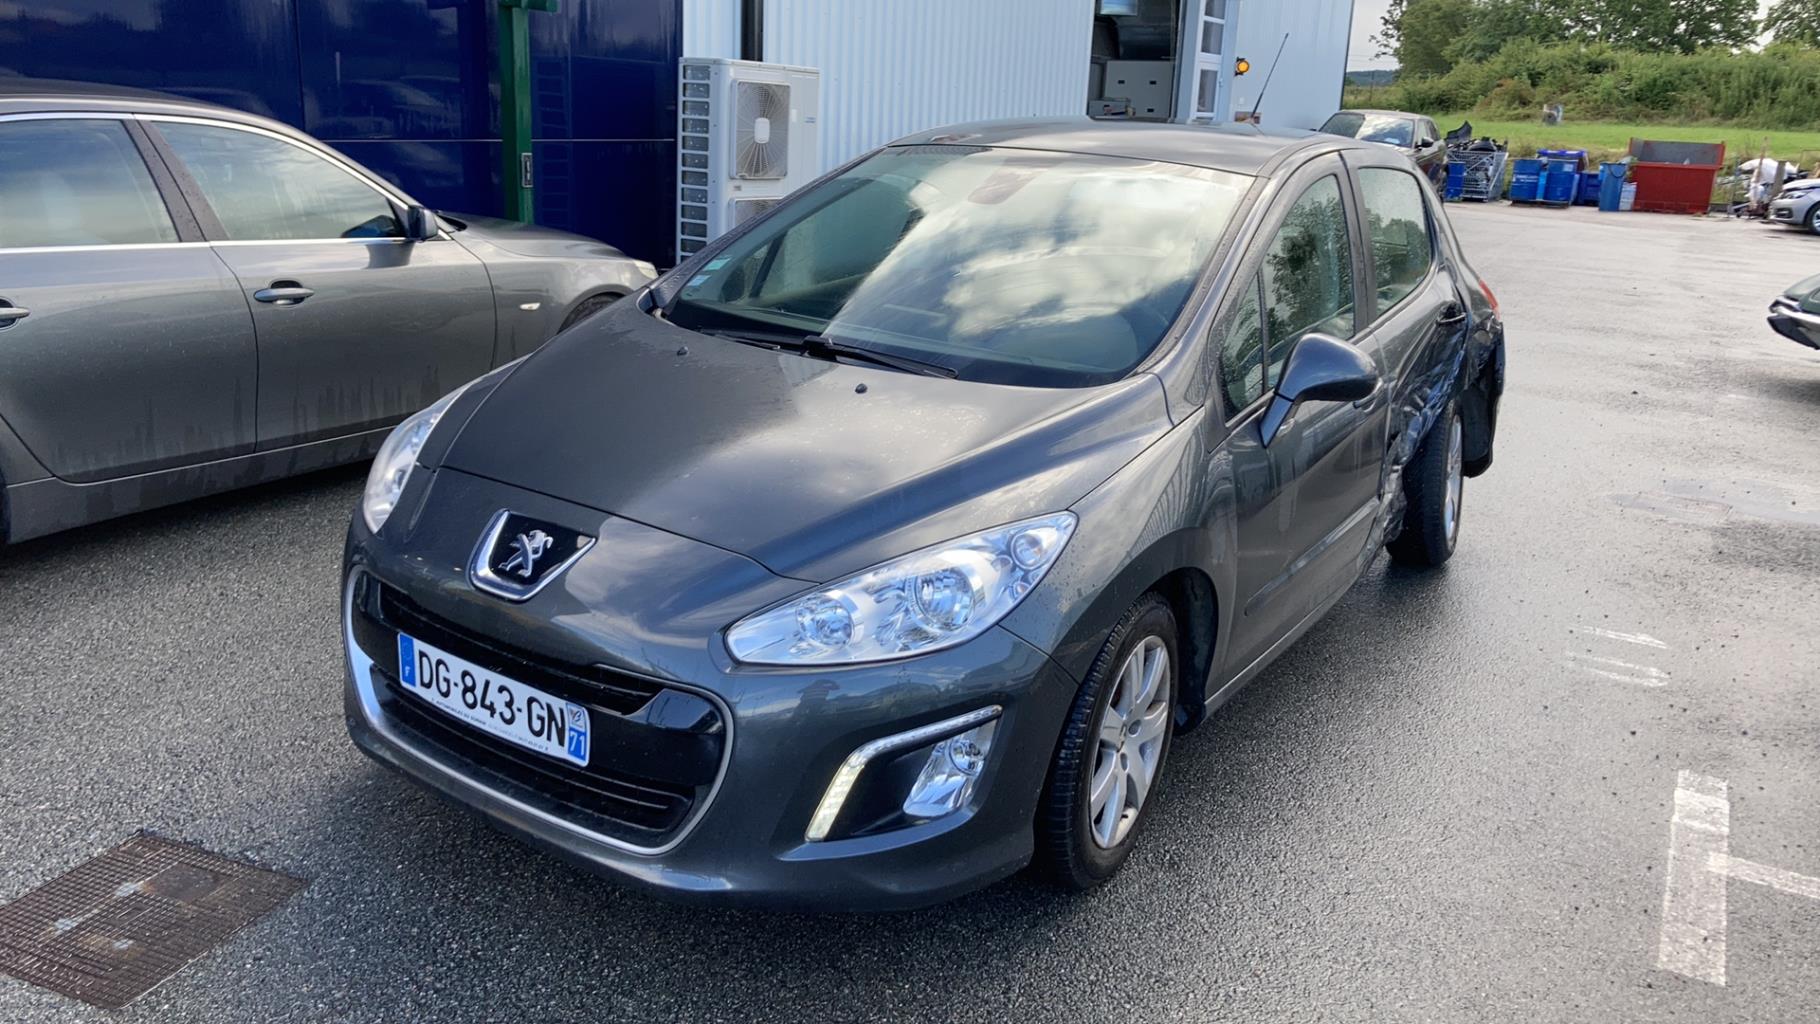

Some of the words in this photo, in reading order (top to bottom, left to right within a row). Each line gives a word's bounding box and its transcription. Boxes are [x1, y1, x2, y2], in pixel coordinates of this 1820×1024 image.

[405, 666, 411, 678] F
[418, 650, 566, 747] DG-843-GN
[570, 731, 585, 757] 71
